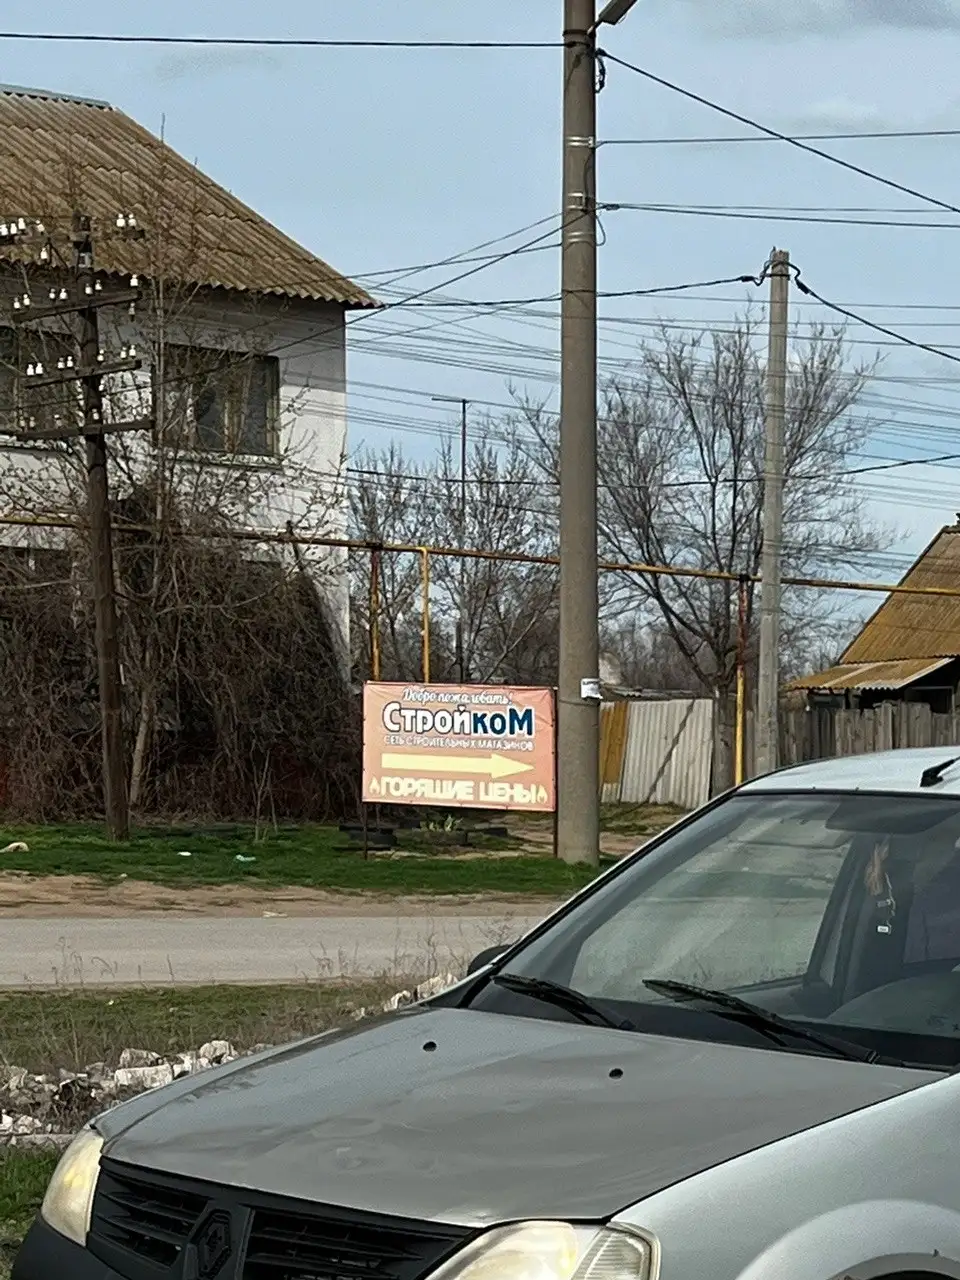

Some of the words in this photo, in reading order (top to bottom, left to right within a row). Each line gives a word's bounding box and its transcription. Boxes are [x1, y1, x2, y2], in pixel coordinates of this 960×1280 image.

[403, 687, 438, 706] Добро
[384, 735, 405, 745] СЕТЬ
[406, 736, 477, 749] СТРОИТЕЛЬНЫХ
[478, 739, 534, 751] МАГАЗИНОВ
[381, 776, 475, 800] ГОРЯЩИЕ
[479, 782, 536, 804] ЦЕНЫ
